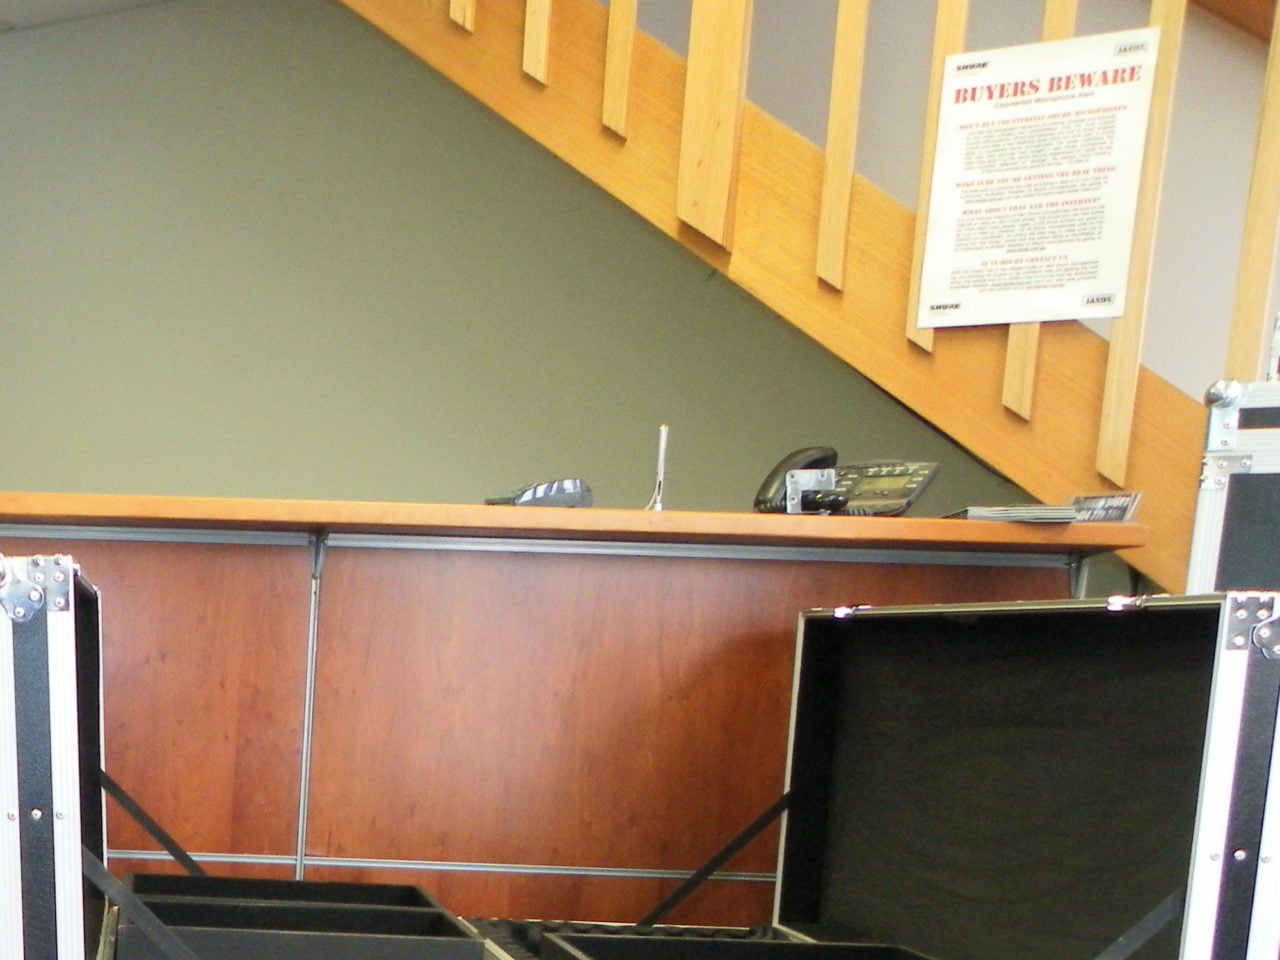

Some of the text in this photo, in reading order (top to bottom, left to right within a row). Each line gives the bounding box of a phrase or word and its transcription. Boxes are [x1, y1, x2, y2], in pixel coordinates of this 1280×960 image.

[956, 61, 988, 71] SHURE
[954, 65, 1142, 104] BUYERS BEWARE
[929, 303, 961, 311] SHURE
